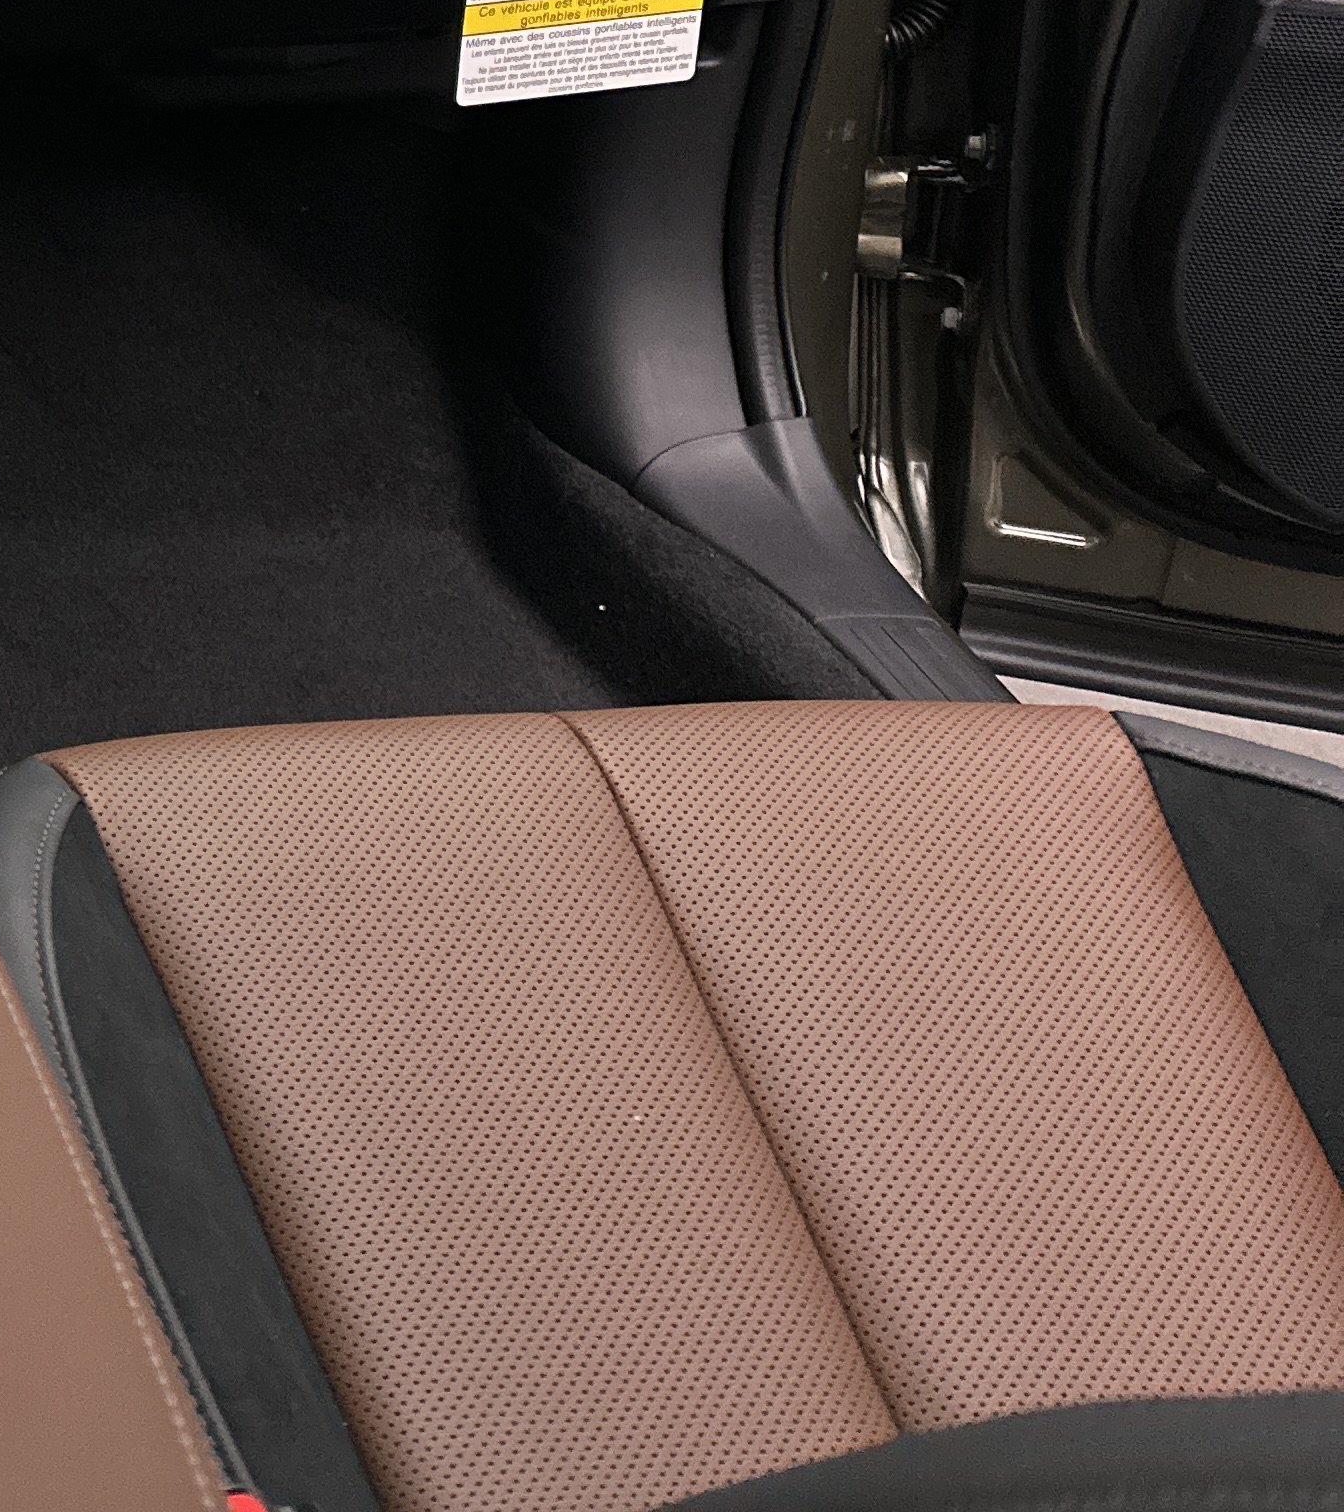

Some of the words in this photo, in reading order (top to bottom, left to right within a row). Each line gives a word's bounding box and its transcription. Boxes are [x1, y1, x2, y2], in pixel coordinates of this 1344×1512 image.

[479, 7, 495, 17] Ce
[502, 0, 549, 15] véhicule
[586, 3, 648, 17] intelligents
[500, 35, 523, 45] avec
[527, 32, 544, 41] des
[549, 28, 590, 39] coussins
[647, 16, 696, 27] intelligents
